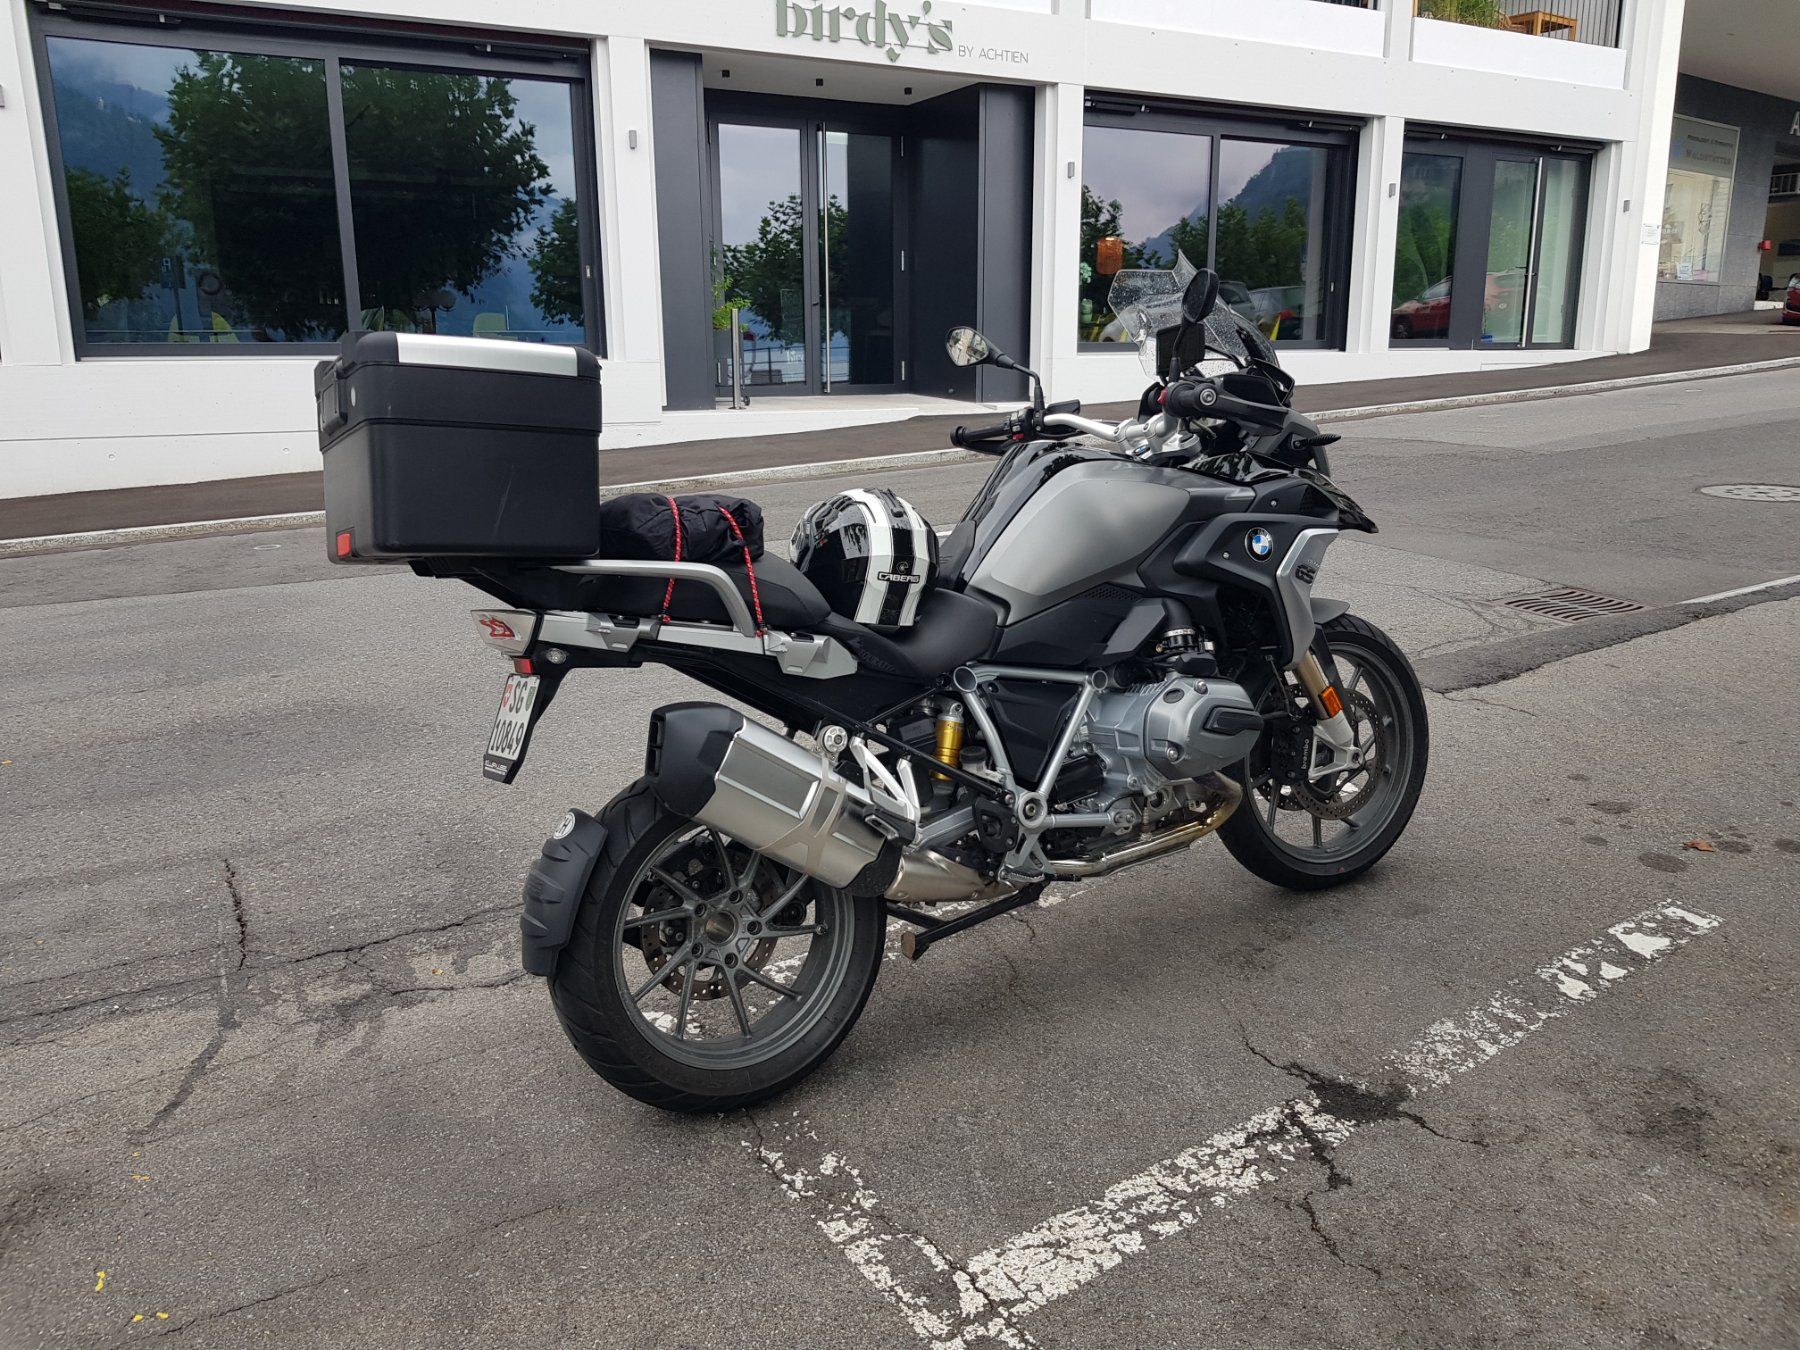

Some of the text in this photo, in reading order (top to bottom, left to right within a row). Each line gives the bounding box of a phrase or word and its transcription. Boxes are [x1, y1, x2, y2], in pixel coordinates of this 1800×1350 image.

[777, 0, 952, 63] birdy's
[958, 45, 1029, 64] BY ACHTIEN
[879, 573, 919, 583] CABERG
[509, 681, 528, 713] SG
[490, 718, 525, 756] 10849
[1301, 738, 1310, 769] brembo
